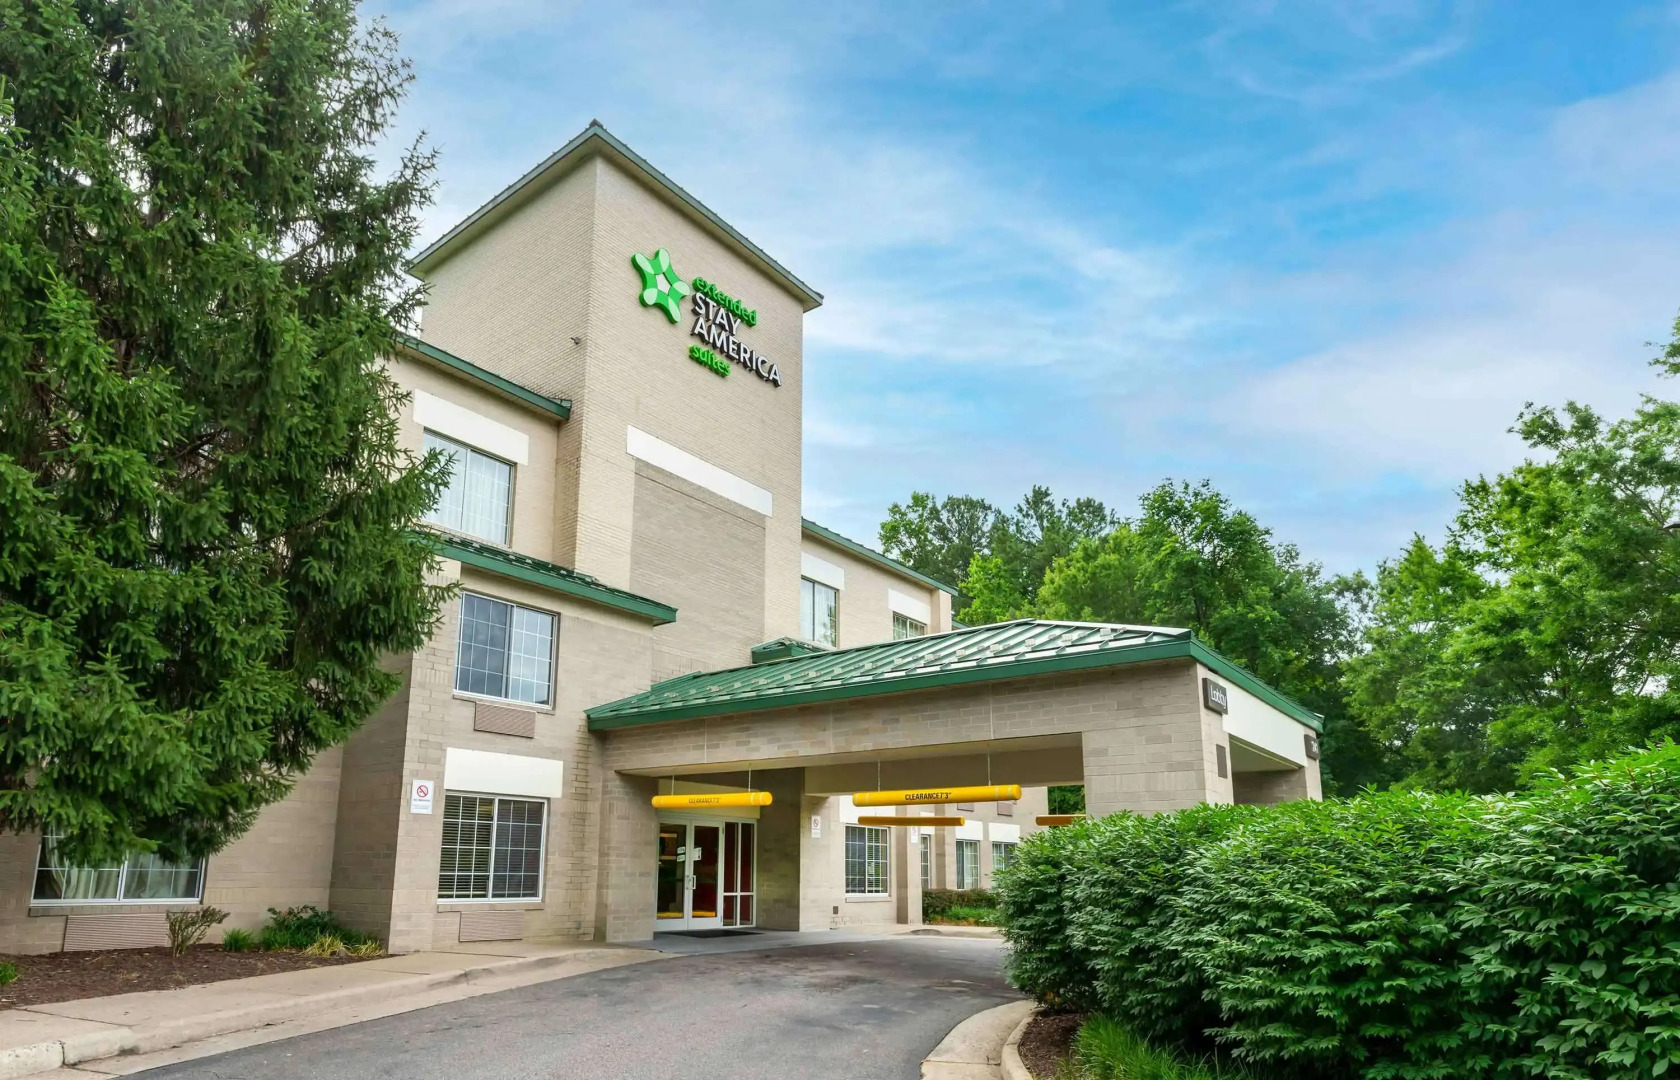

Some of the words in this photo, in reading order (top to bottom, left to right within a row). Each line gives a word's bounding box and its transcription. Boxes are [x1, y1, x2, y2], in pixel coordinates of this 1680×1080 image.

[693, 277, 757, 326] extended
[693, 292, 741, 336] STAY
[690, 345, 731, 376] suites
[692, 317, 781, 387] AMERICA
[1210, 684, 1227, 710] Lobby
[904, 792, 939, 801] CLEARANCE
